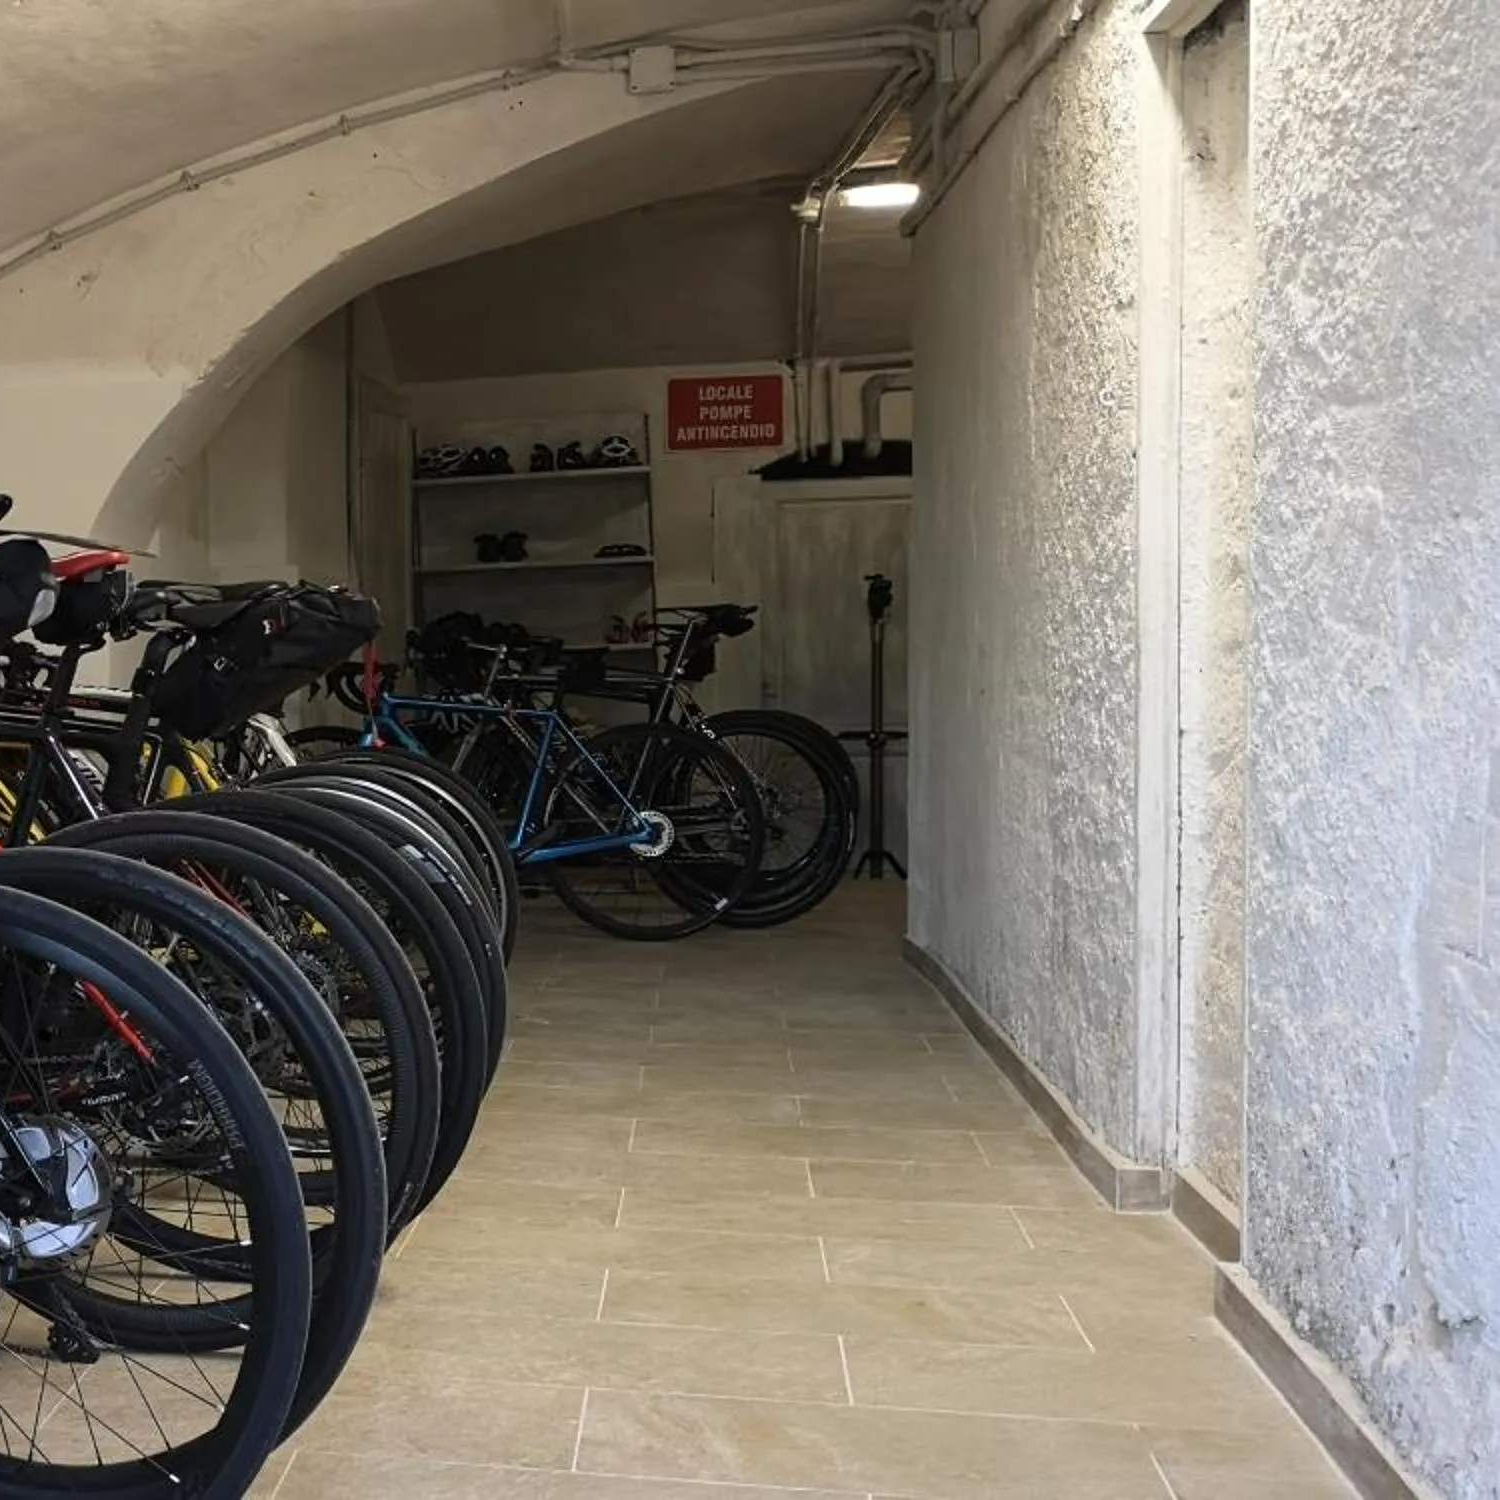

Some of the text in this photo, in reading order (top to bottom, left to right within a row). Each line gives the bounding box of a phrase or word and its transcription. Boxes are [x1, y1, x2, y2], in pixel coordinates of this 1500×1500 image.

[698, 384, 754, 401] LOCALE
[699, 404, 753, 421] POMPE
[675, 423, 776, 442] ANTINCENDIO
